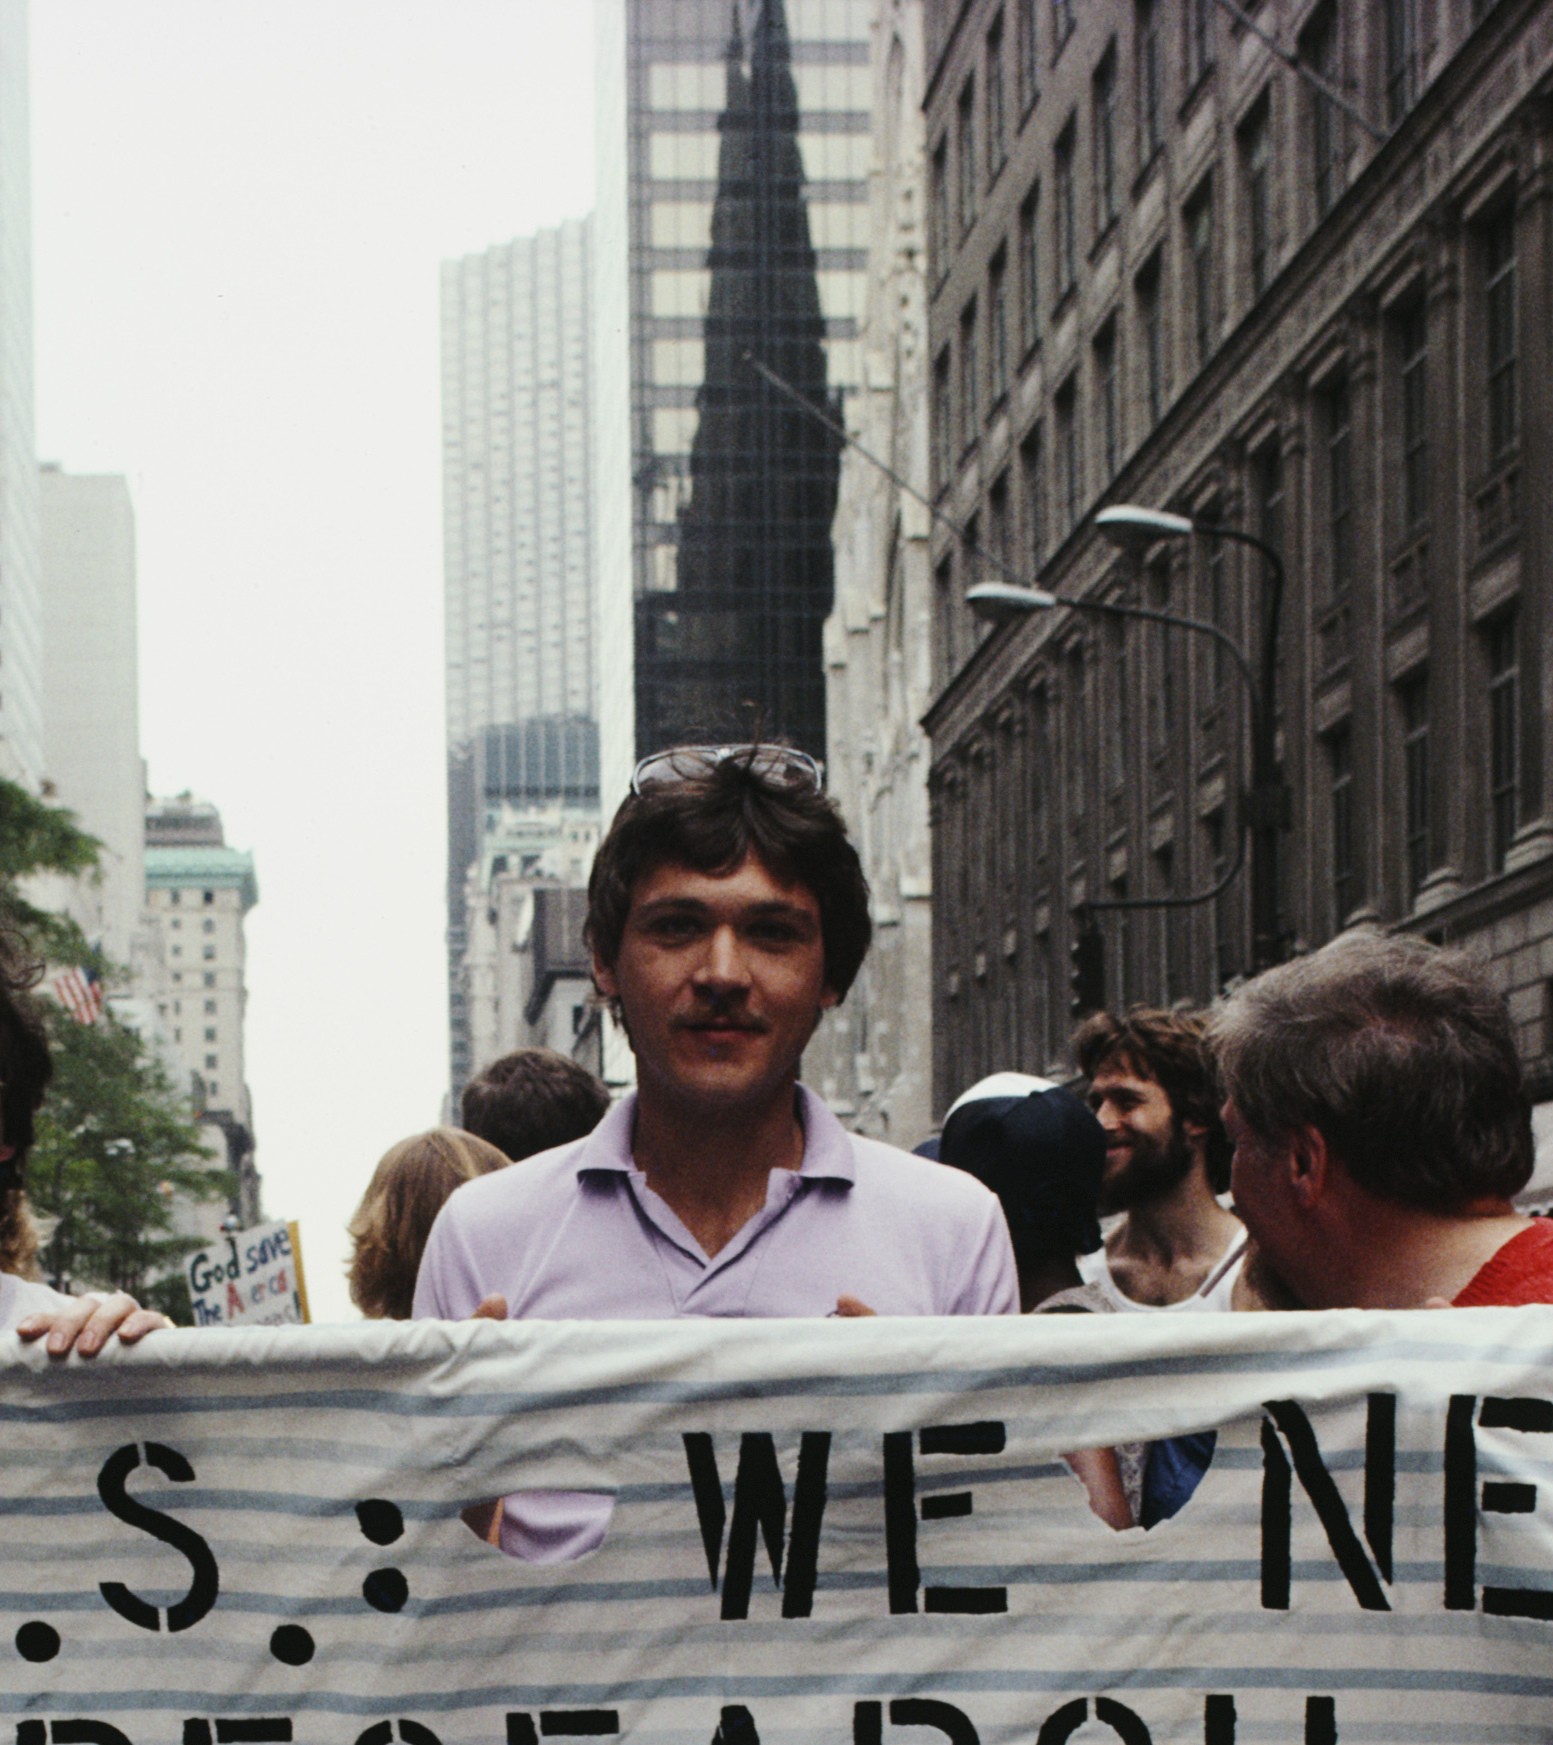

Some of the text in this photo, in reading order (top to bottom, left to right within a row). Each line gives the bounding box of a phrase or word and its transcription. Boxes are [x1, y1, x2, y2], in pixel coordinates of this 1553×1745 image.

[191, 1229, 292, 1293] God save
[681, 1420, 1008, 1621] WE
